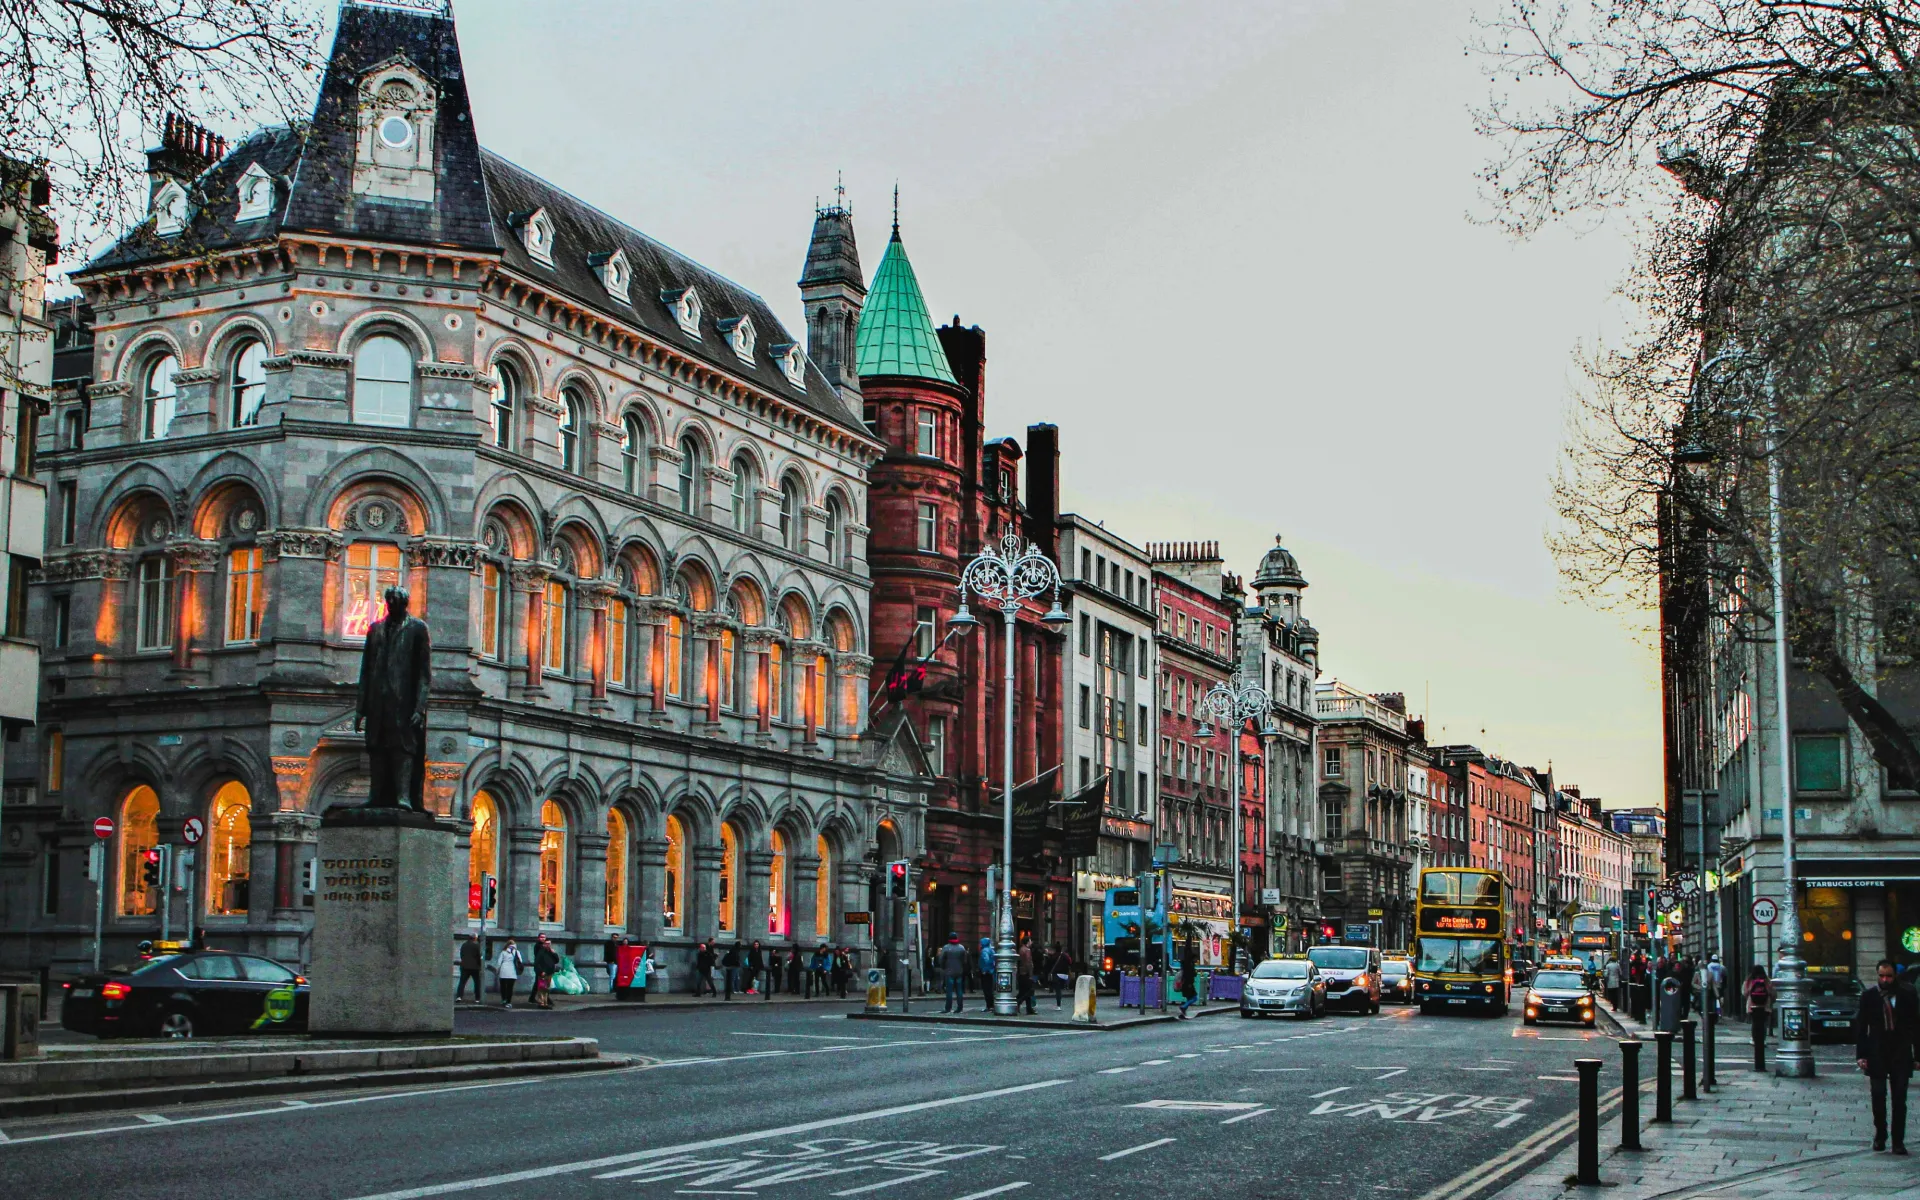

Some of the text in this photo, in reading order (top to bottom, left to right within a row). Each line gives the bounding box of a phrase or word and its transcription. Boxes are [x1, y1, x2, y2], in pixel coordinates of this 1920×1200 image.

[1677, 889, 1700, 899] COFFEE
[1657, 903, 1678, 913] COFFEE
[1475, 918, 1487, 929] 79
